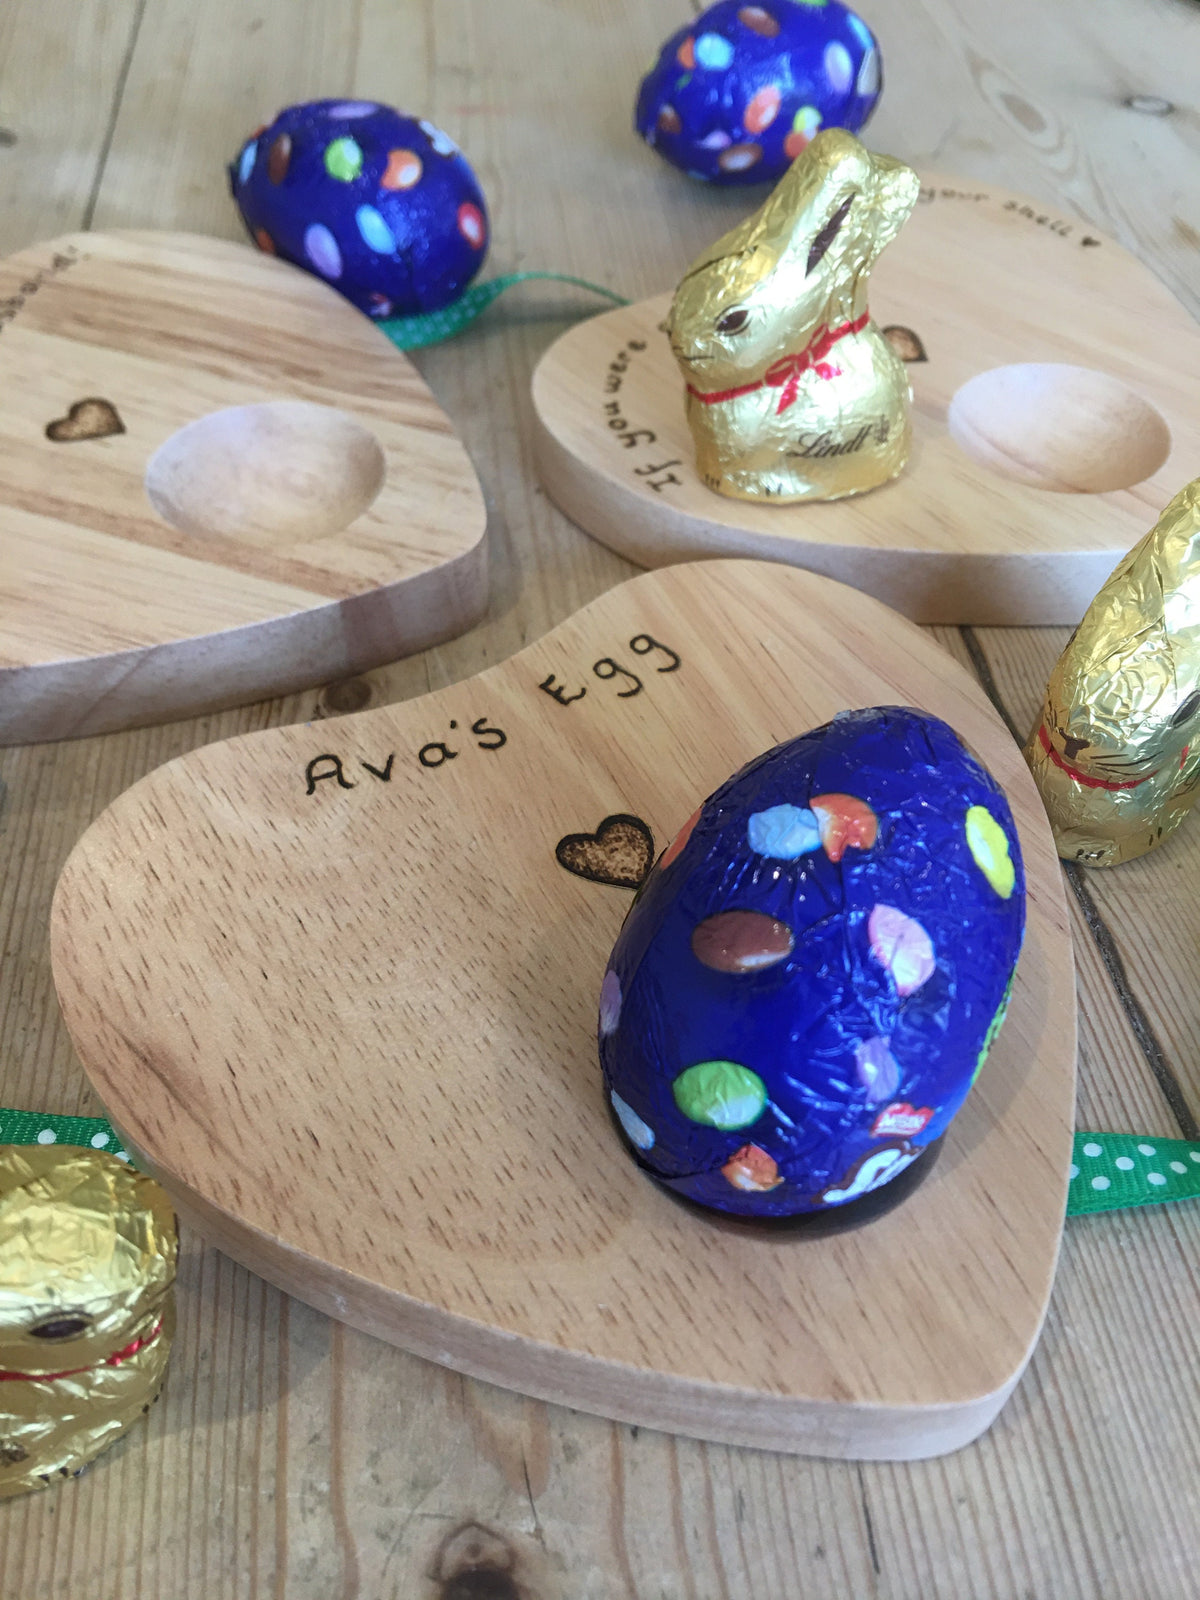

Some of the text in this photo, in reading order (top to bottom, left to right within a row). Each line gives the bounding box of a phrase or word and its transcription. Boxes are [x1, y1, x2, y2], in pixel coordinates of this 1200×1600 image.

[604, 340, 647, 394] were
[603, 400, 657, 449] you
[785, 423, 873, 459] Lindt
[305, 633, 682, 796] Ava's Egg
